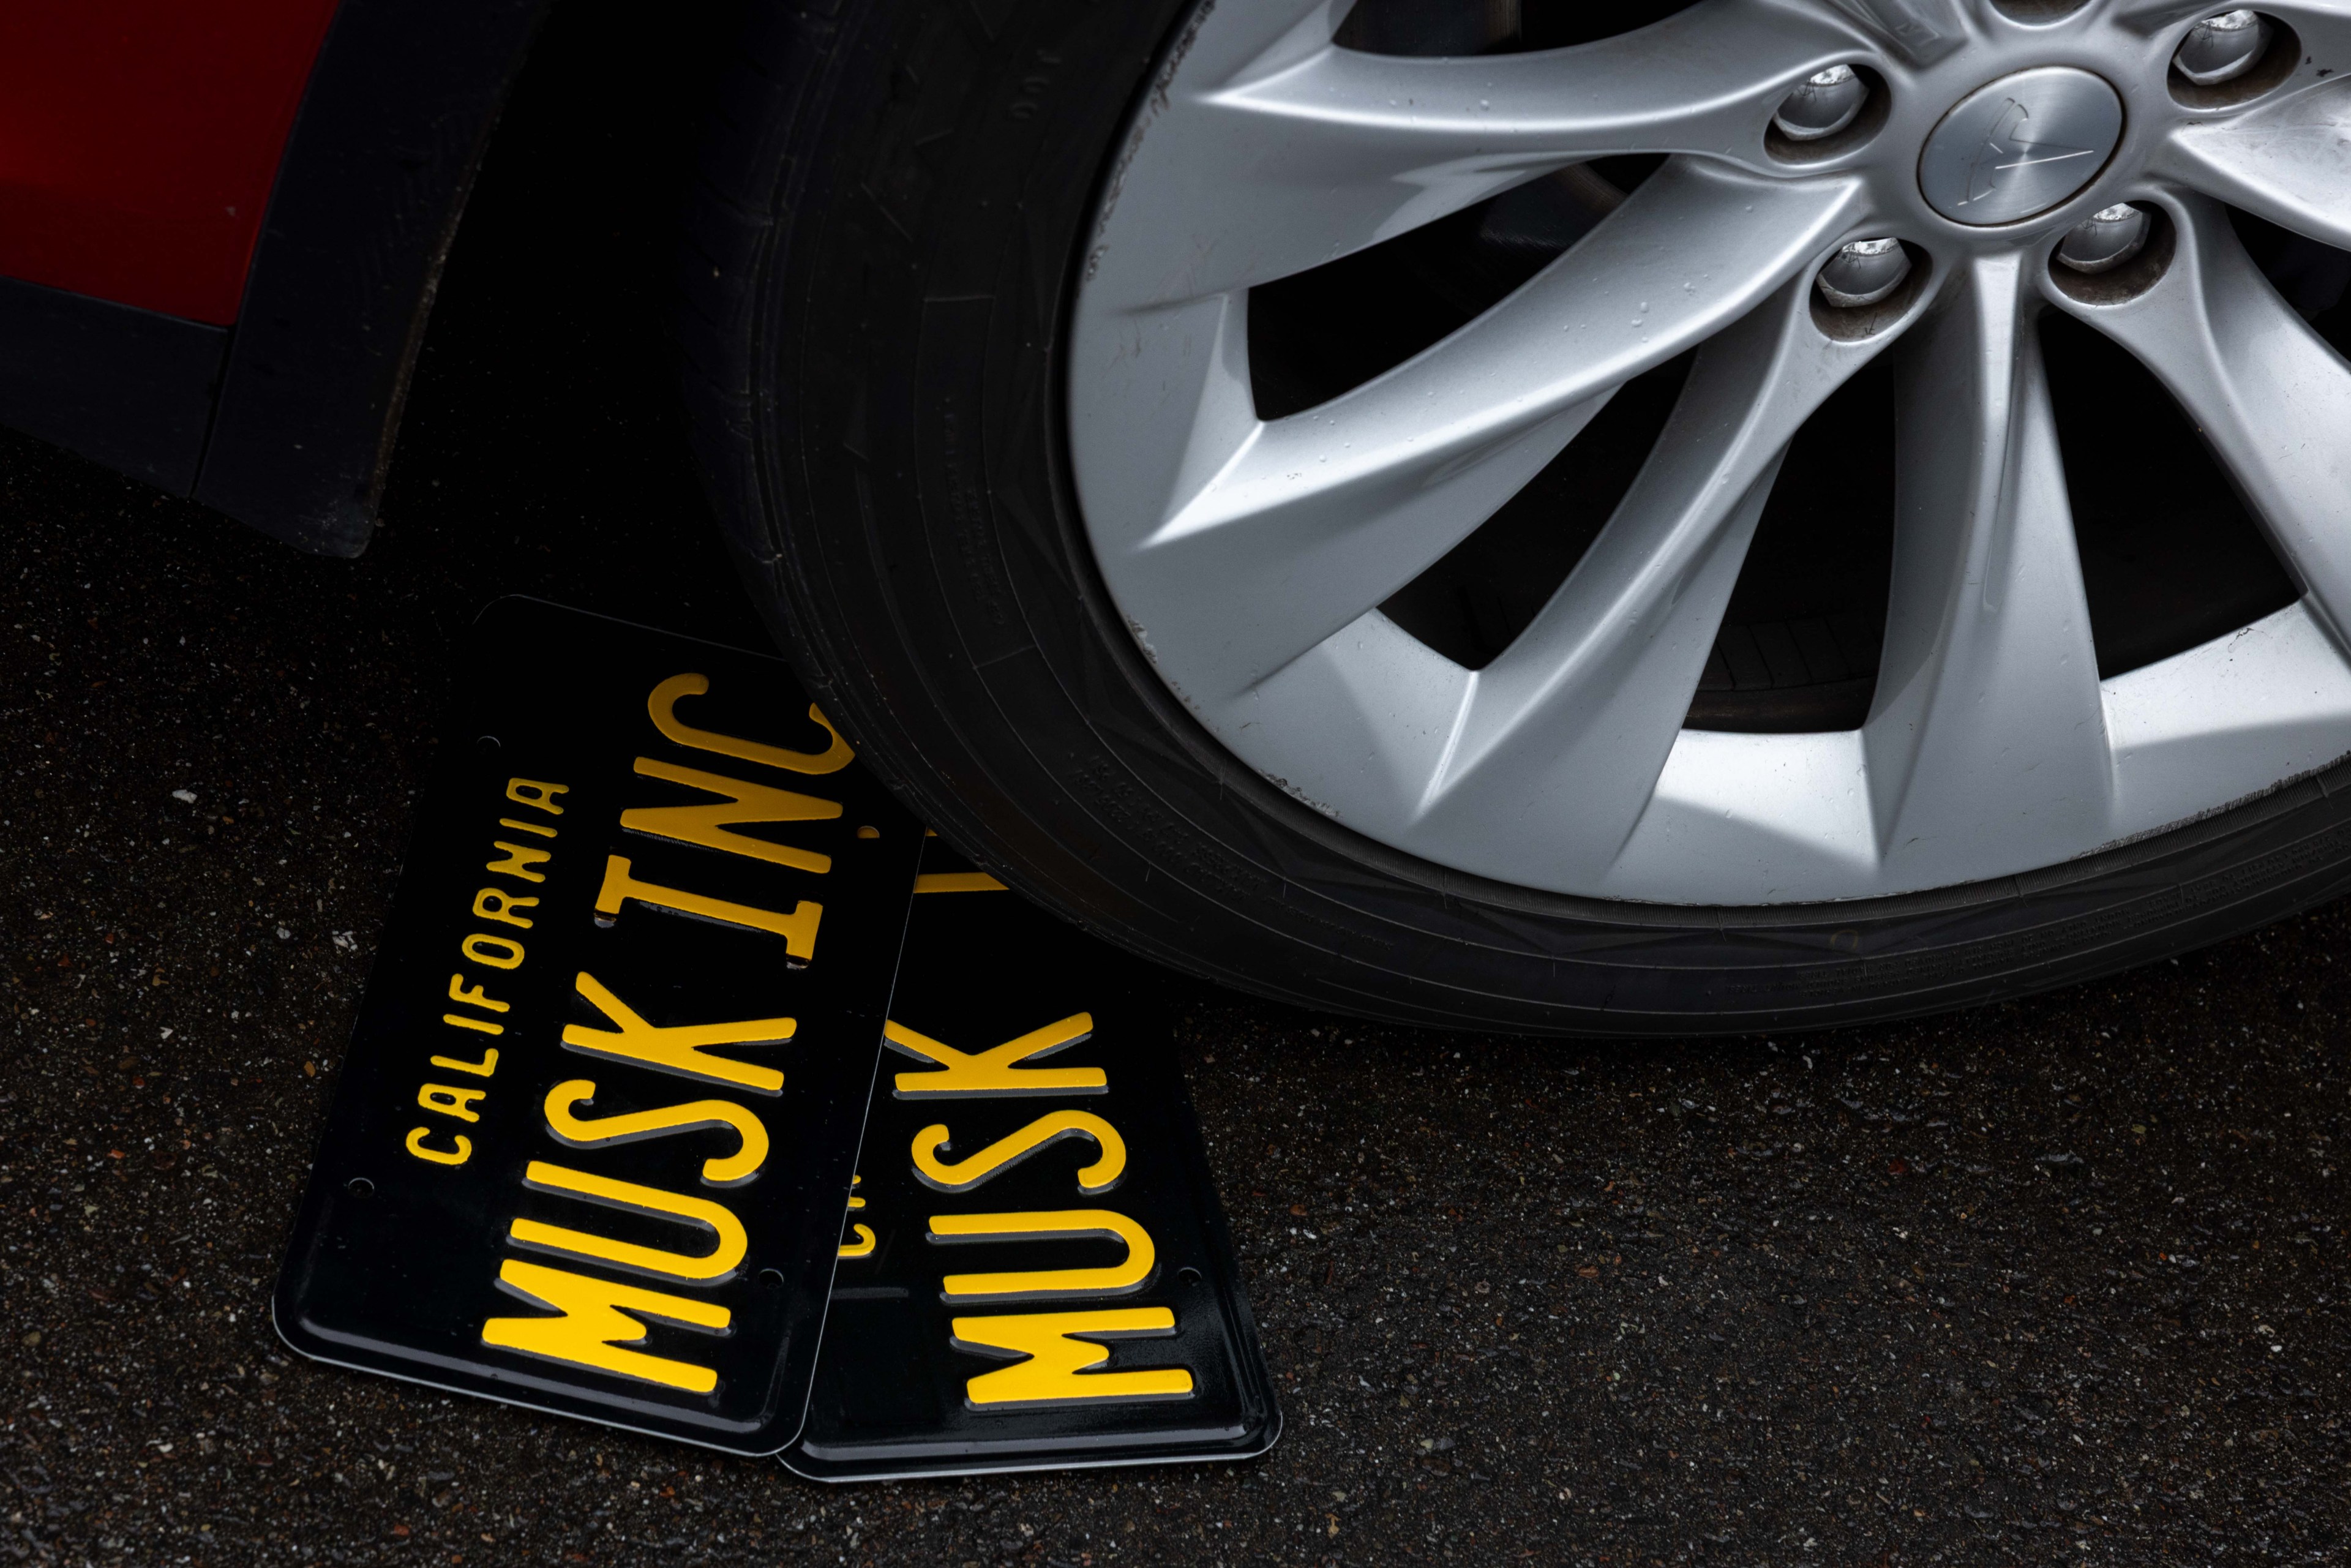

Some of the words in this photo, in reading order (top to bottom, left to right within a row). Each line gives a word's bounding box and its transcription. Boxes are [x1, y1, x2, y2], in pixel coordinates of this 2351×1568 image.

[405, 778, 569, 1166] CALIFORNIA
[594, 675, 855, 961] INC
[481, 971, 798, 1394] MUSK
[883, 1011, 1194, 1405] MUSK
